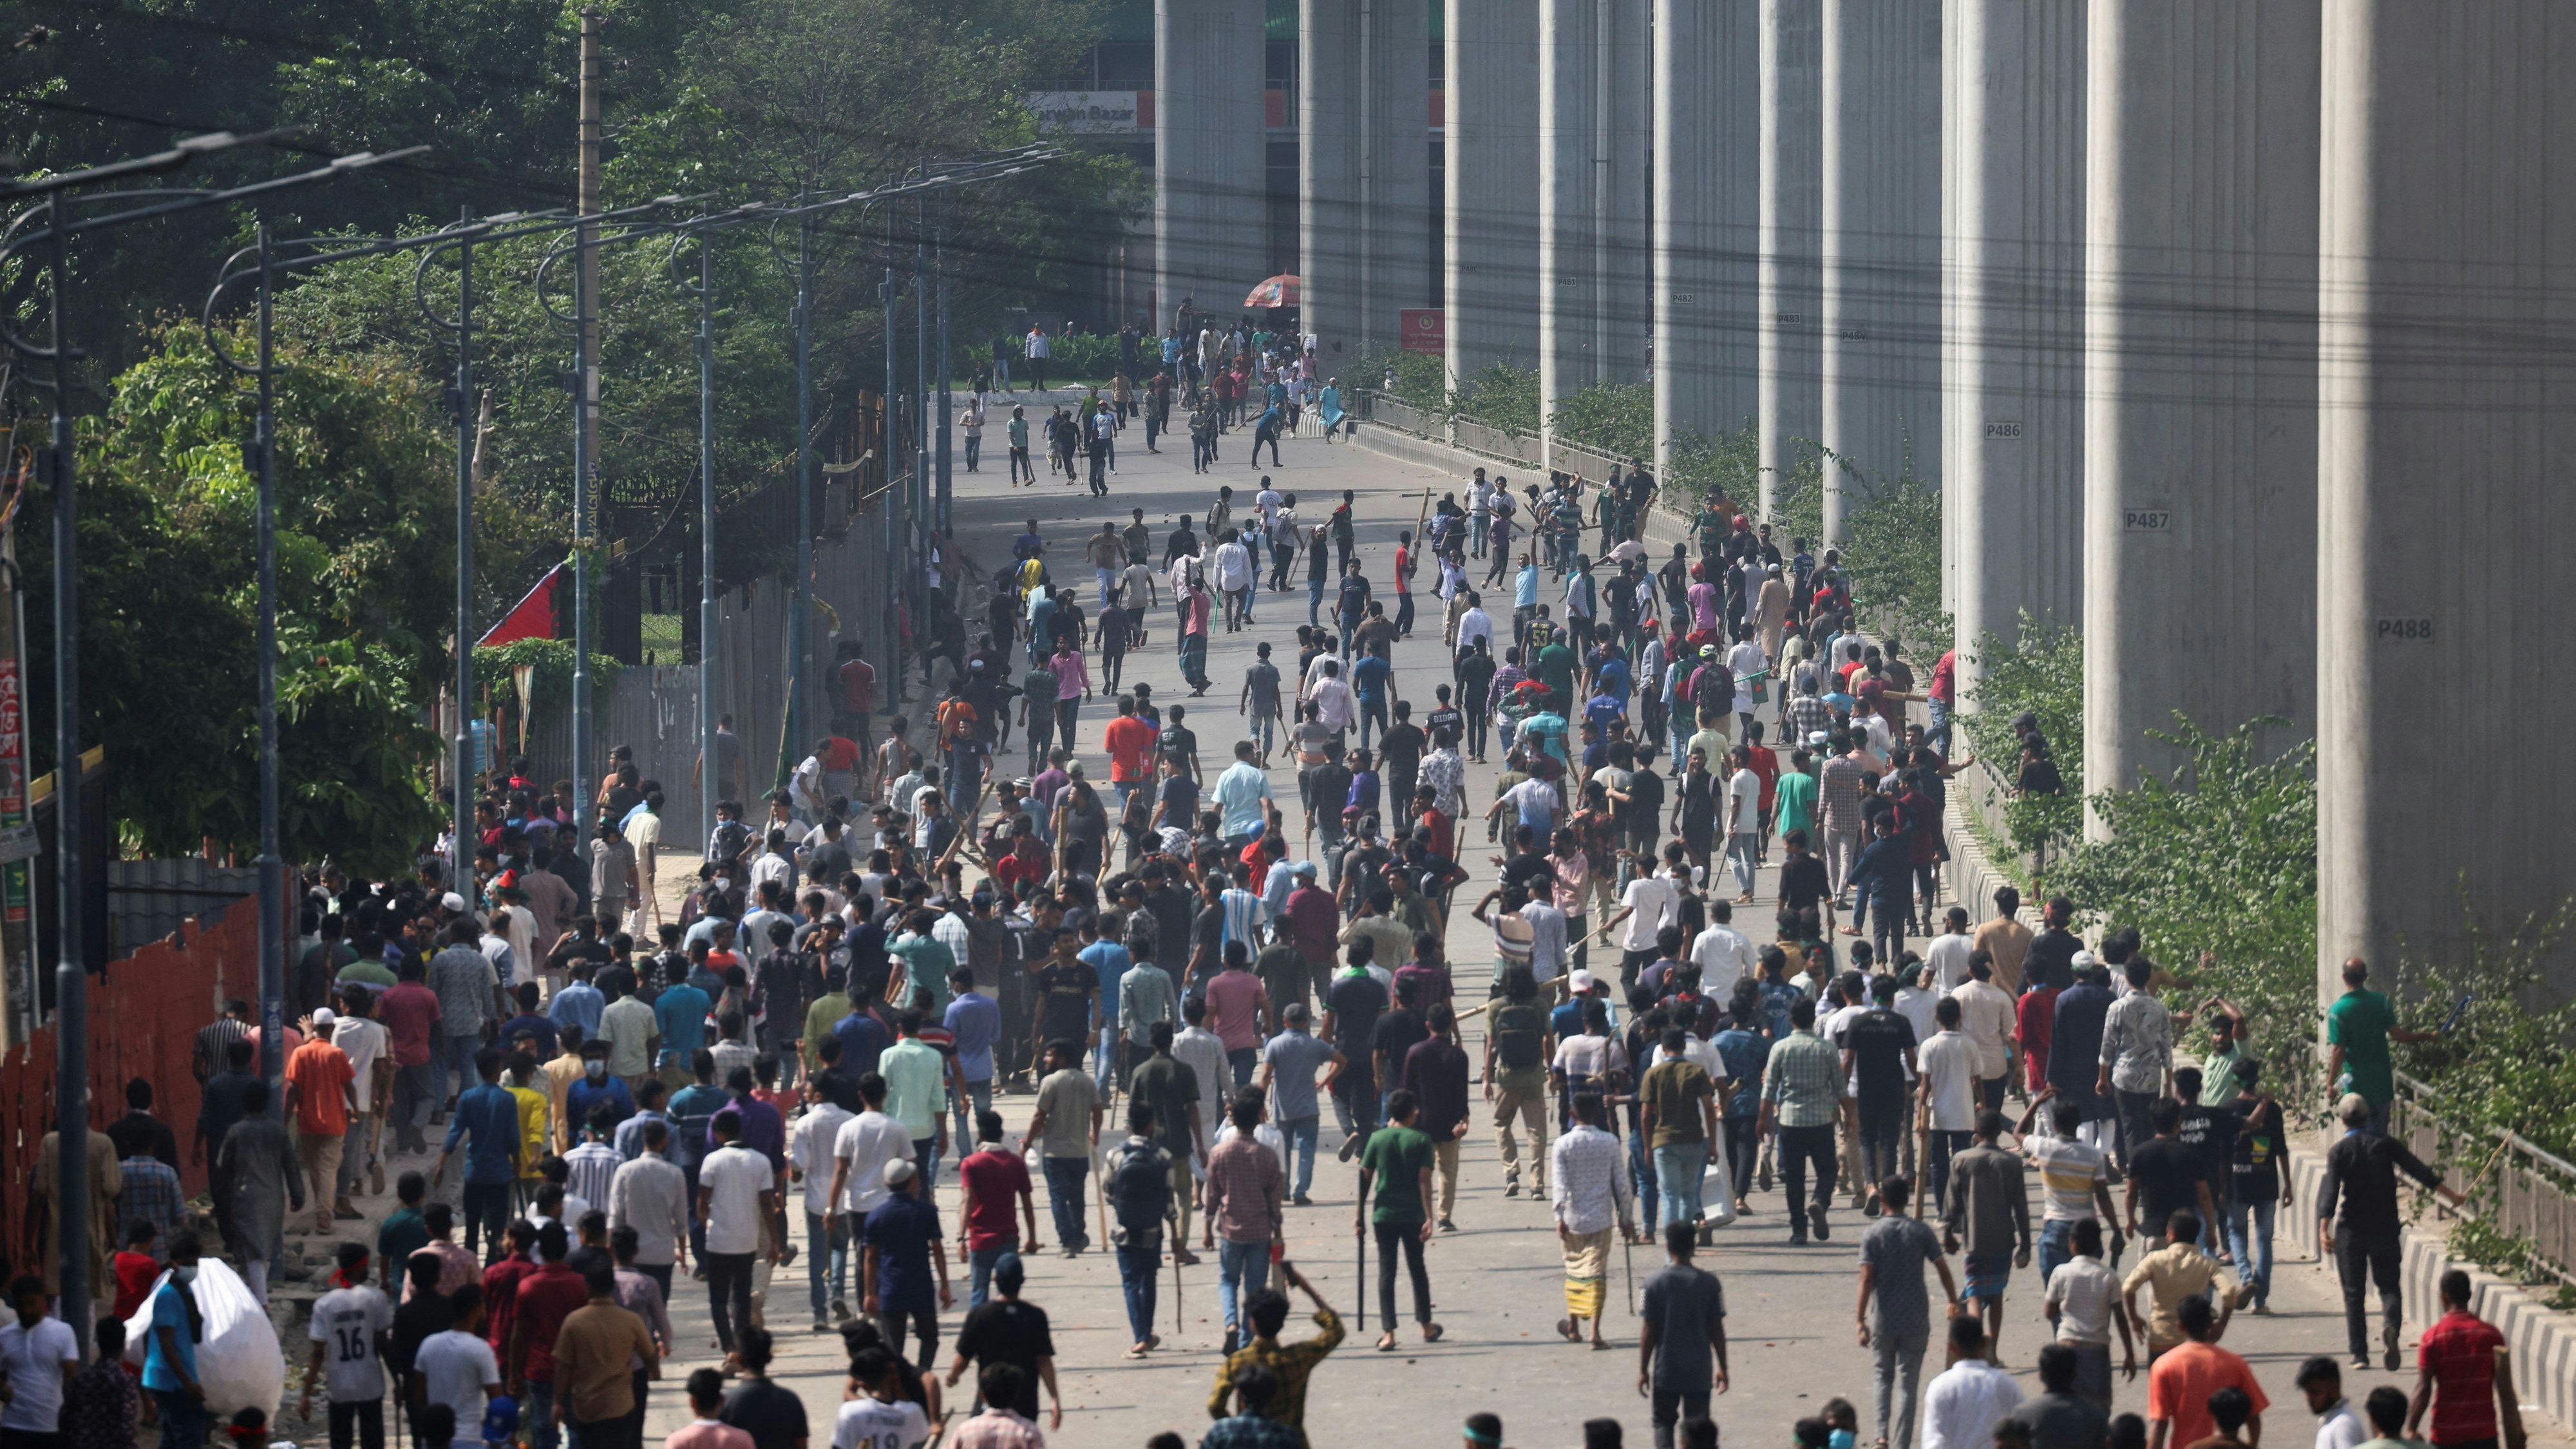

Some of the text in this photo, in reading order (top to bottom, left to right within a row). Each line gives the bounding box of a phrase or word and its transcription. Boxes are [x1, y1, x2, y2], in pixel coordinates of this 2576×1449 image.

[1088, 106, 1134, 120] Bazar
[1558, 278, 1576, 286] P481
[1672, 294, 1692, 303] P482
[1778, 314, 1800, 323] P483
[1987, 424, 2020, 437] P486
[2126, 513, 2168, 528] P487
[2378, 618, 2431, 639] P488
[1533, 629, 1548, 647] 53
[1434, 712, 1457, 723] DIDAR
[2232, 1163, 2252, 1173] YOUR
[336, 1327, 366, 1361] 16
